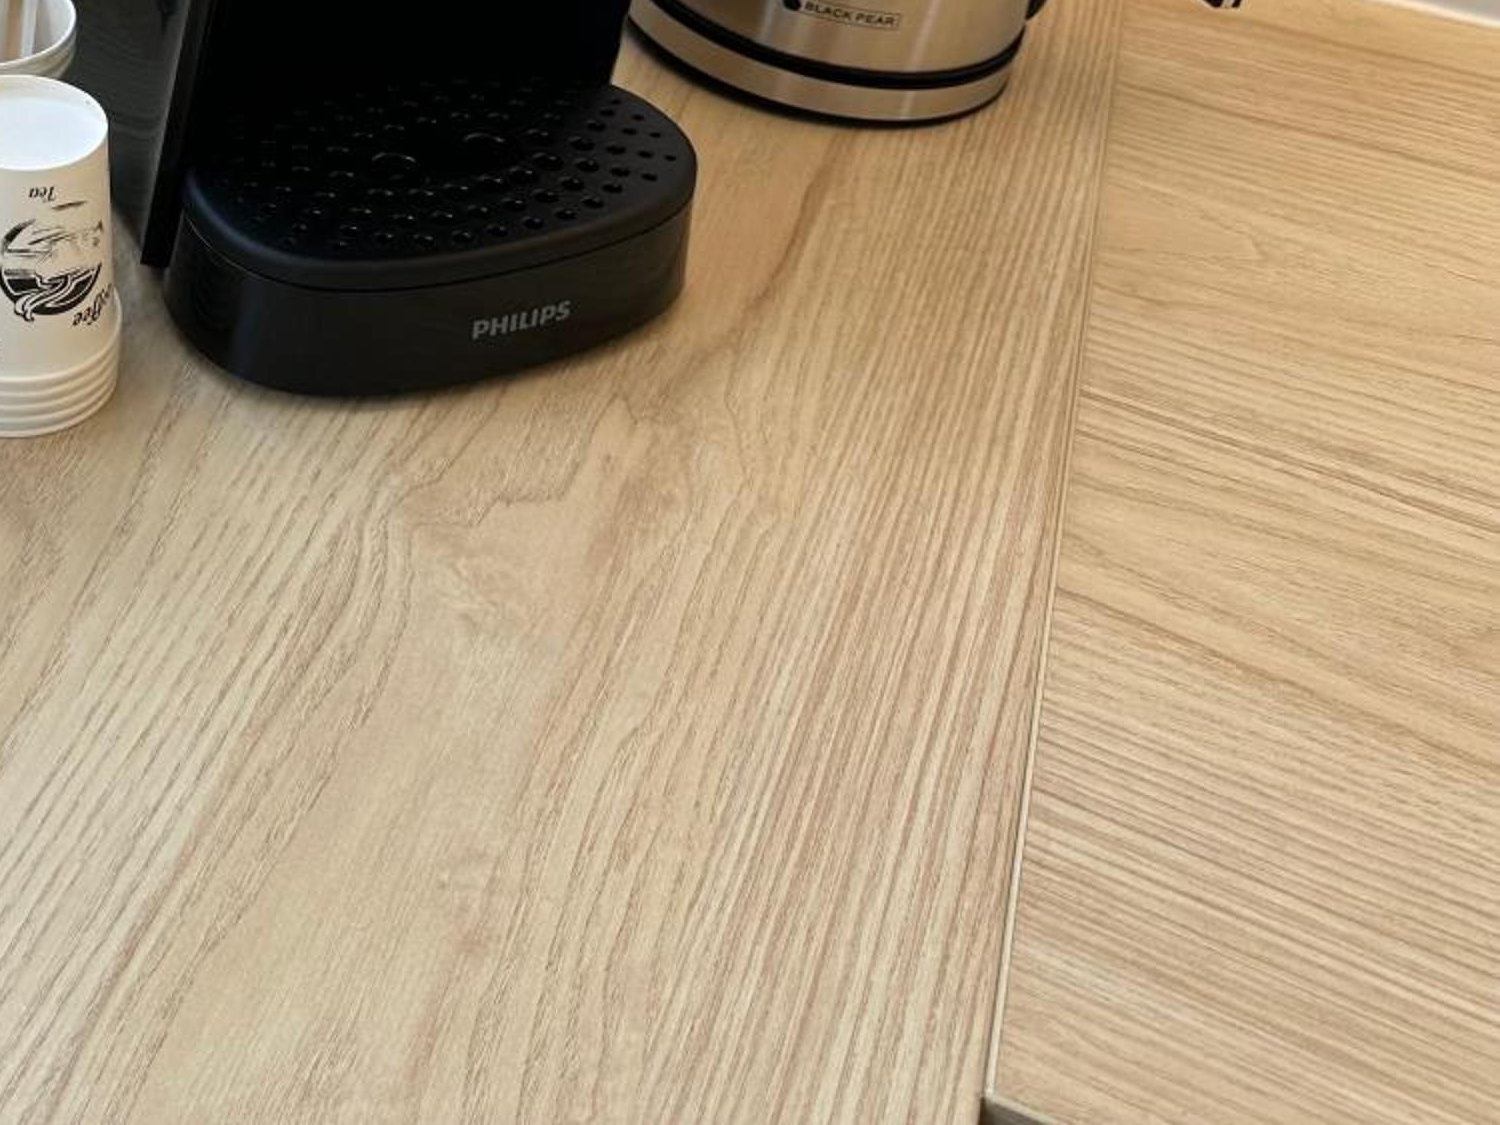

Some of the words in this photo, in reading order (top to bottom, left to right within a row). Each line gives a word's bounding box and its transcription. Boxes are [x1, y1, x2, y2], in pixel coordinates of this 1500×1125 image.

[804, 0, 851, 20] BLACK
[855, 12, 895, 25] PEAR
[28, 186, 57, 203] Tea
[471, 299, 571, 340] PHILIPS
